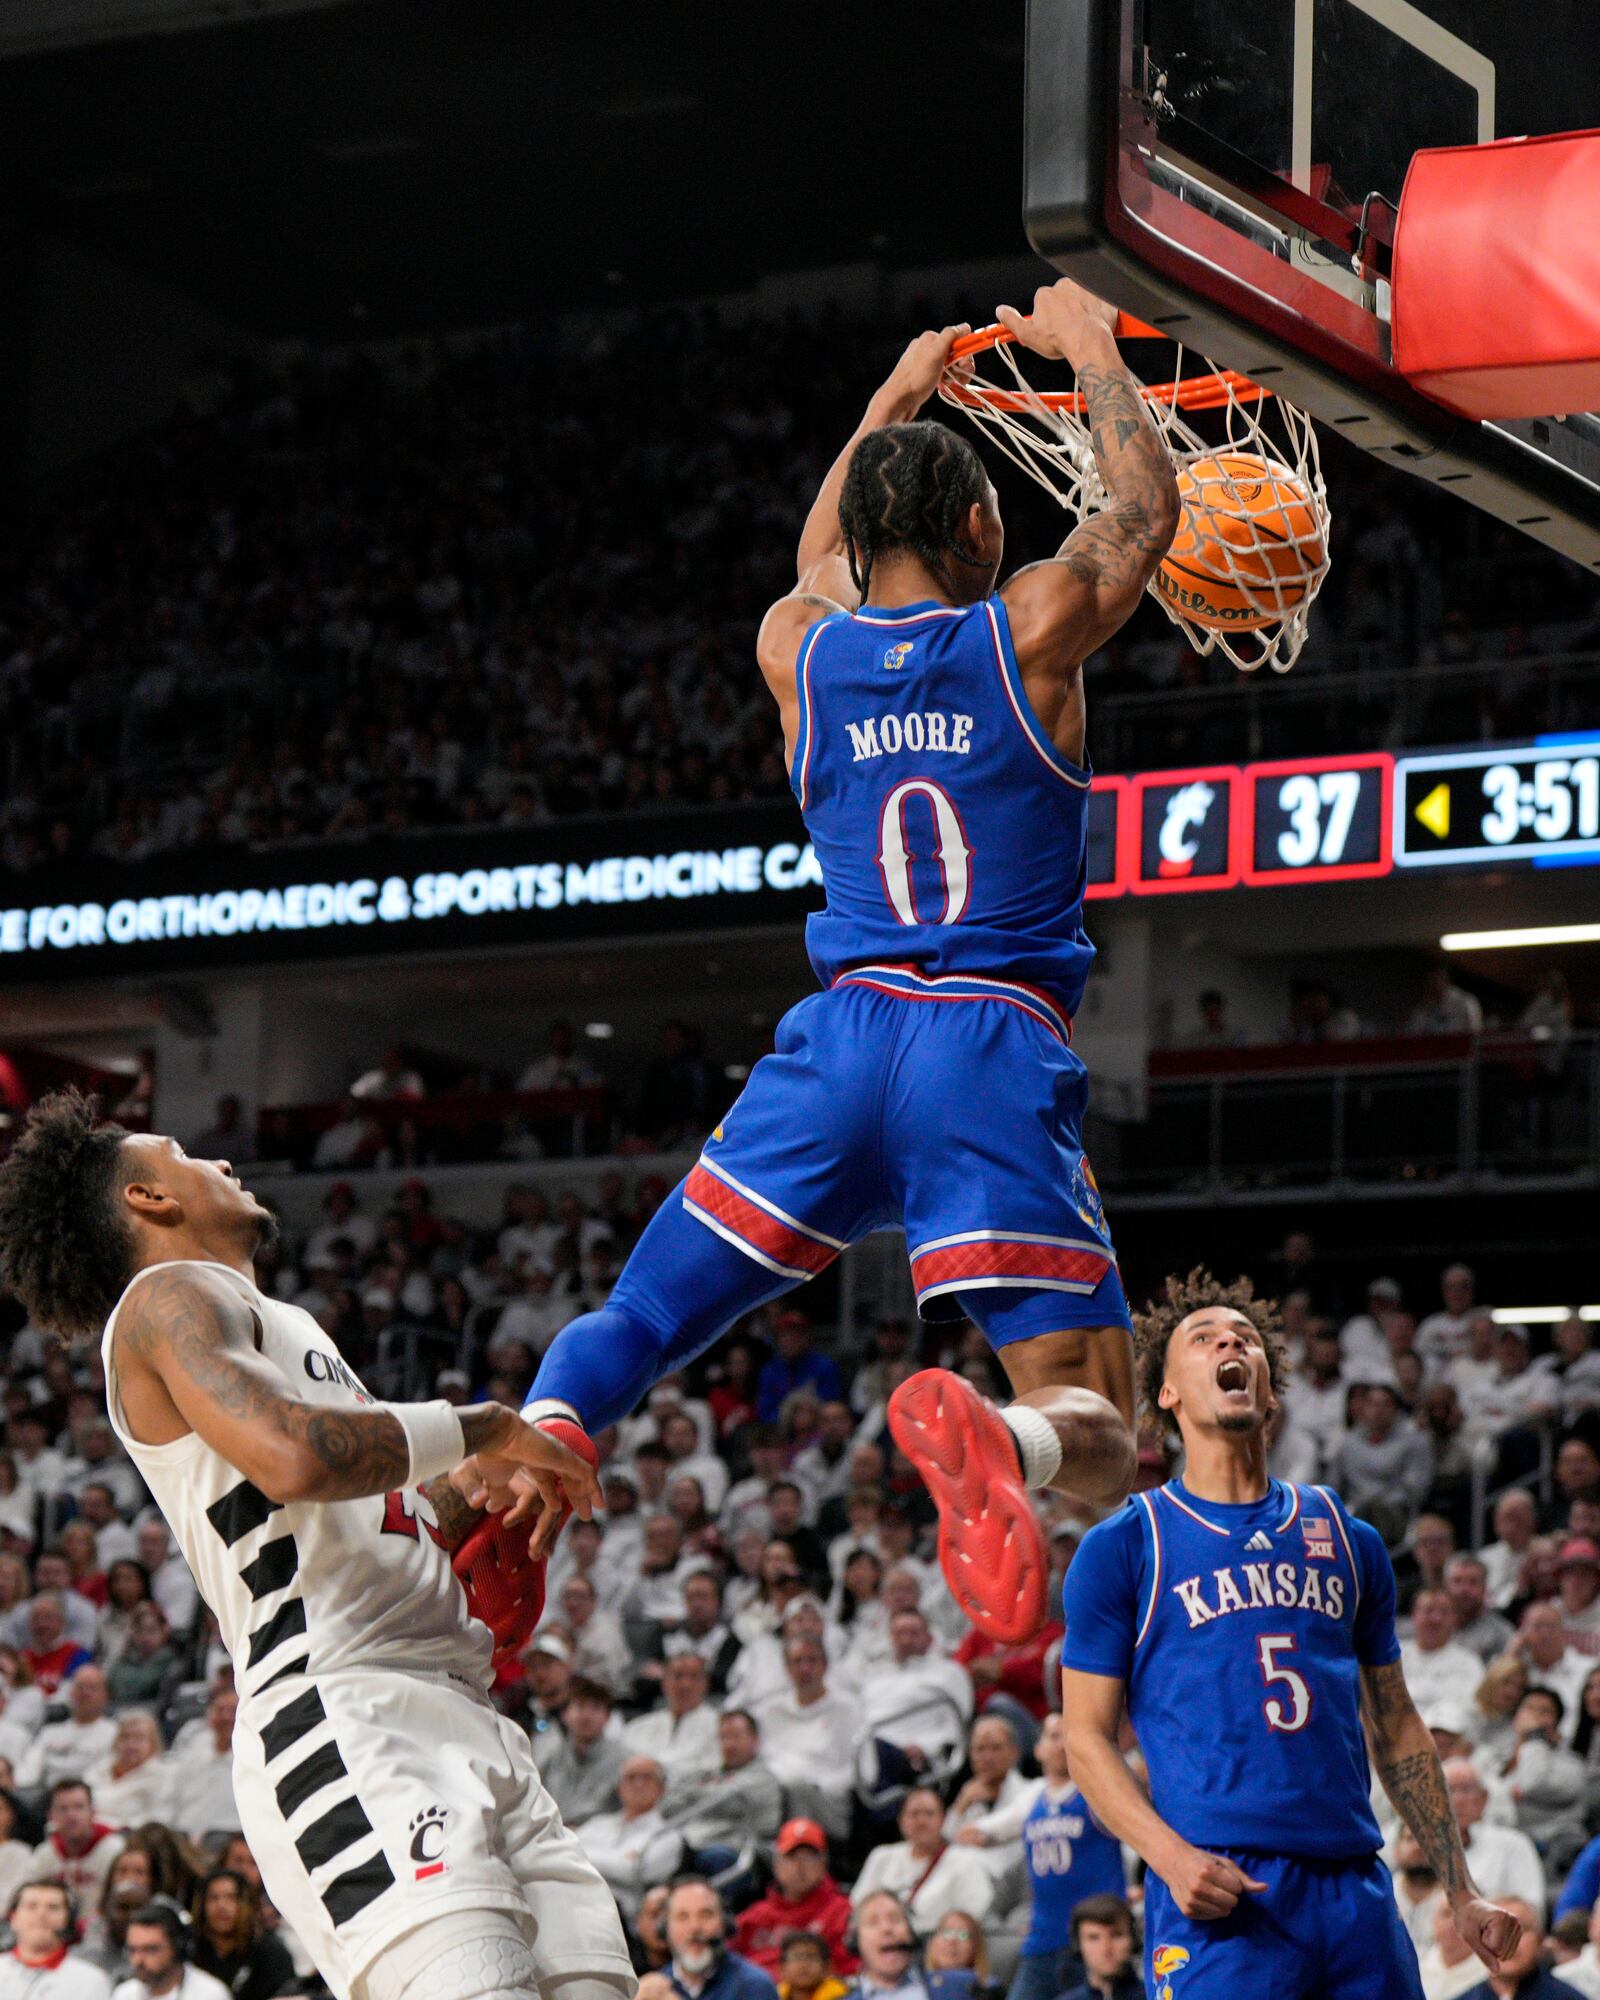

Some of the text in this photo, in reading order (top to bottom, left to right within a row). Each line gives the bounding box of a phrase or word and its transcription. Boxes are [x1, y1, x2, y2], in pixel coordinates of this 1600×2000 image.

[1156, 566, 1261, 620] Wilson
[845, 712, 973, 762] MOORE
[1277, 772, 1361, 866] 37
[1482, 758, 1599, 845] 3:51
[874, 777, 976, 926] 0
[29, 903, 106, 950] FOR
[107, 879, 377, 944] ORTHOPAEDIC
[378, 876, 411, 922] &
[412, 863, 563, 919] SPORTS
[564, 845, 763, 905] MEDICINE
[1173, 1563, 1344, 1629] KANSAS
[1258, 1634, 1312, 1732] 5
